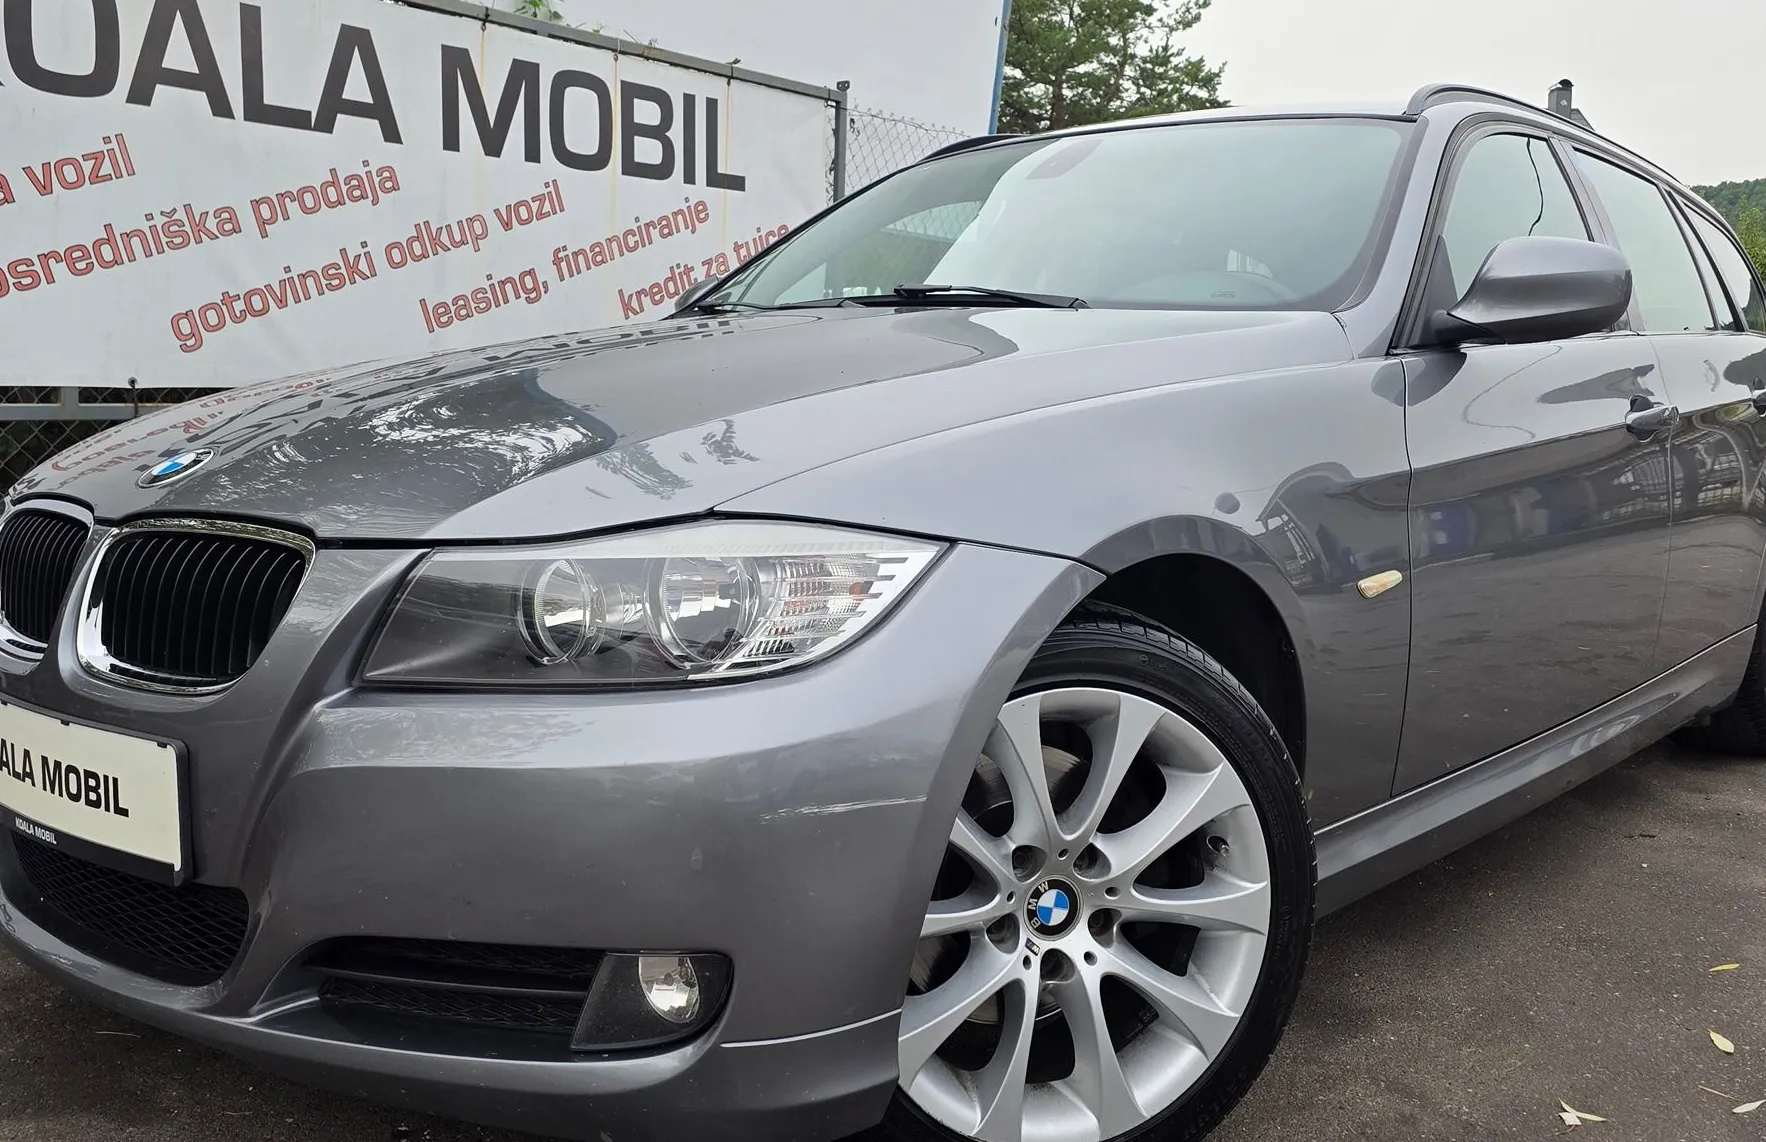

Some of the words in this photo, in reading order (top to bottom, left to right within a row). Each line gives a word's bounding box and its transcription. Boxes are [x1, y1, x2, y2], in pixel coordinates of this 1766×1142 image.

[0, 0, 403, 145] OALA
[441, 44, 745, 192] MOBIL
[22, 133, 135, 196] vozil
[250, 160, 400, 239] prodaja
[171, 241, 377, 353] gotovinski
[384, 213, 488, 269] odkup
[493, 179, 564, 231] vozil
[419, 266, 549, 333] leasing,
[552, 197, 710, 282] financiranje
[618, 263, 698, 320] kredit
[702, 251, 730, 279] za
[41, 754, 129, 818] MOBIL
[15, 816, 34, 836] KOALA
[35, 825, 57, 845] MOBIL
[1027, 881, 1050, 929] BMW
